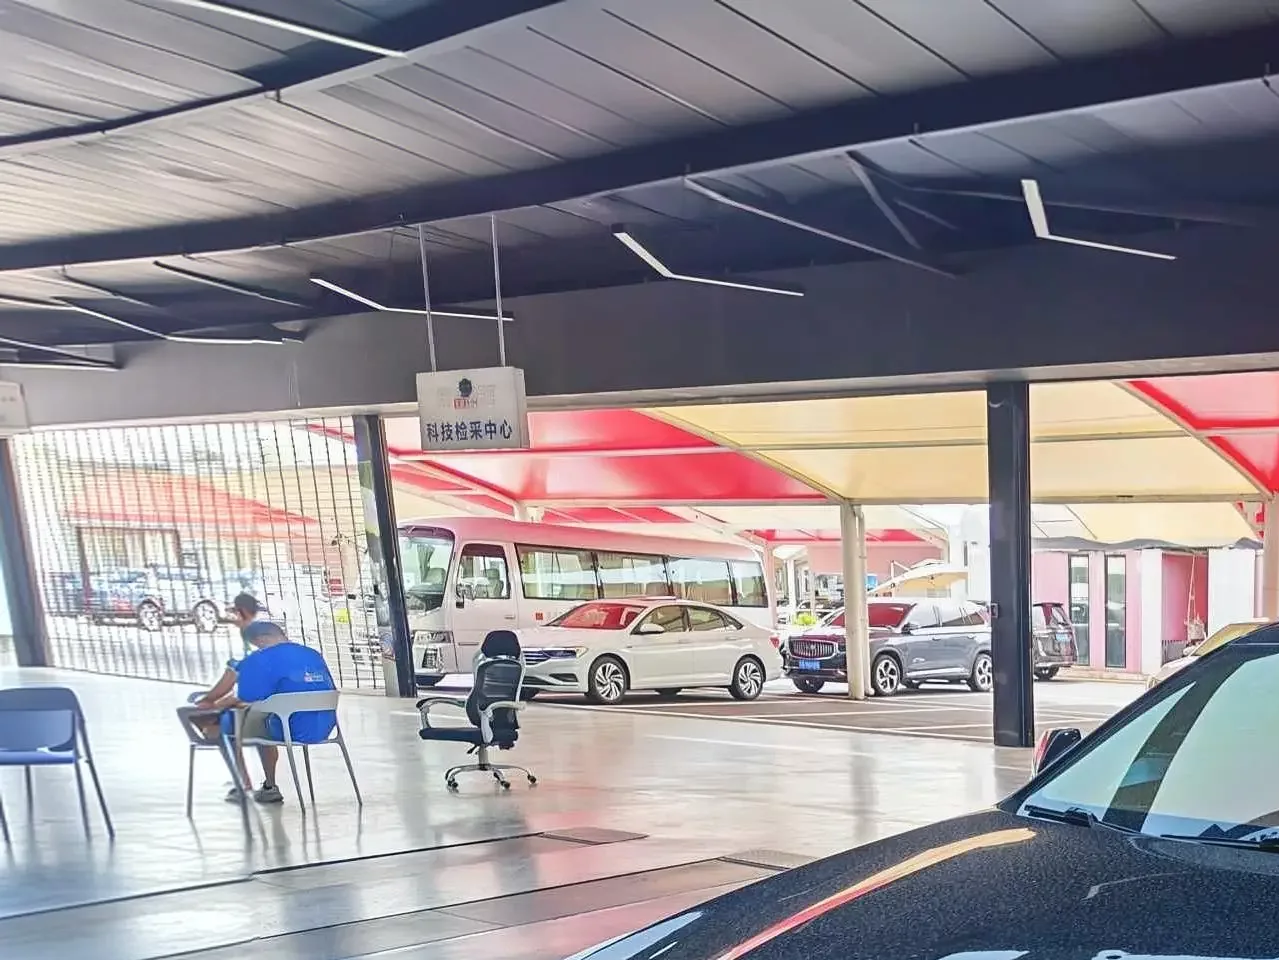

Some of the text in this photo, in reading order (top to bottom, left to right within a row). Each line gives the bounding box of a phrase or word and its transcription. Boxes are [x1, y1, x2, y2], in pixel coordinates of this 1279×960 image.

[426, 420, 513, 442] 科技检采中心
